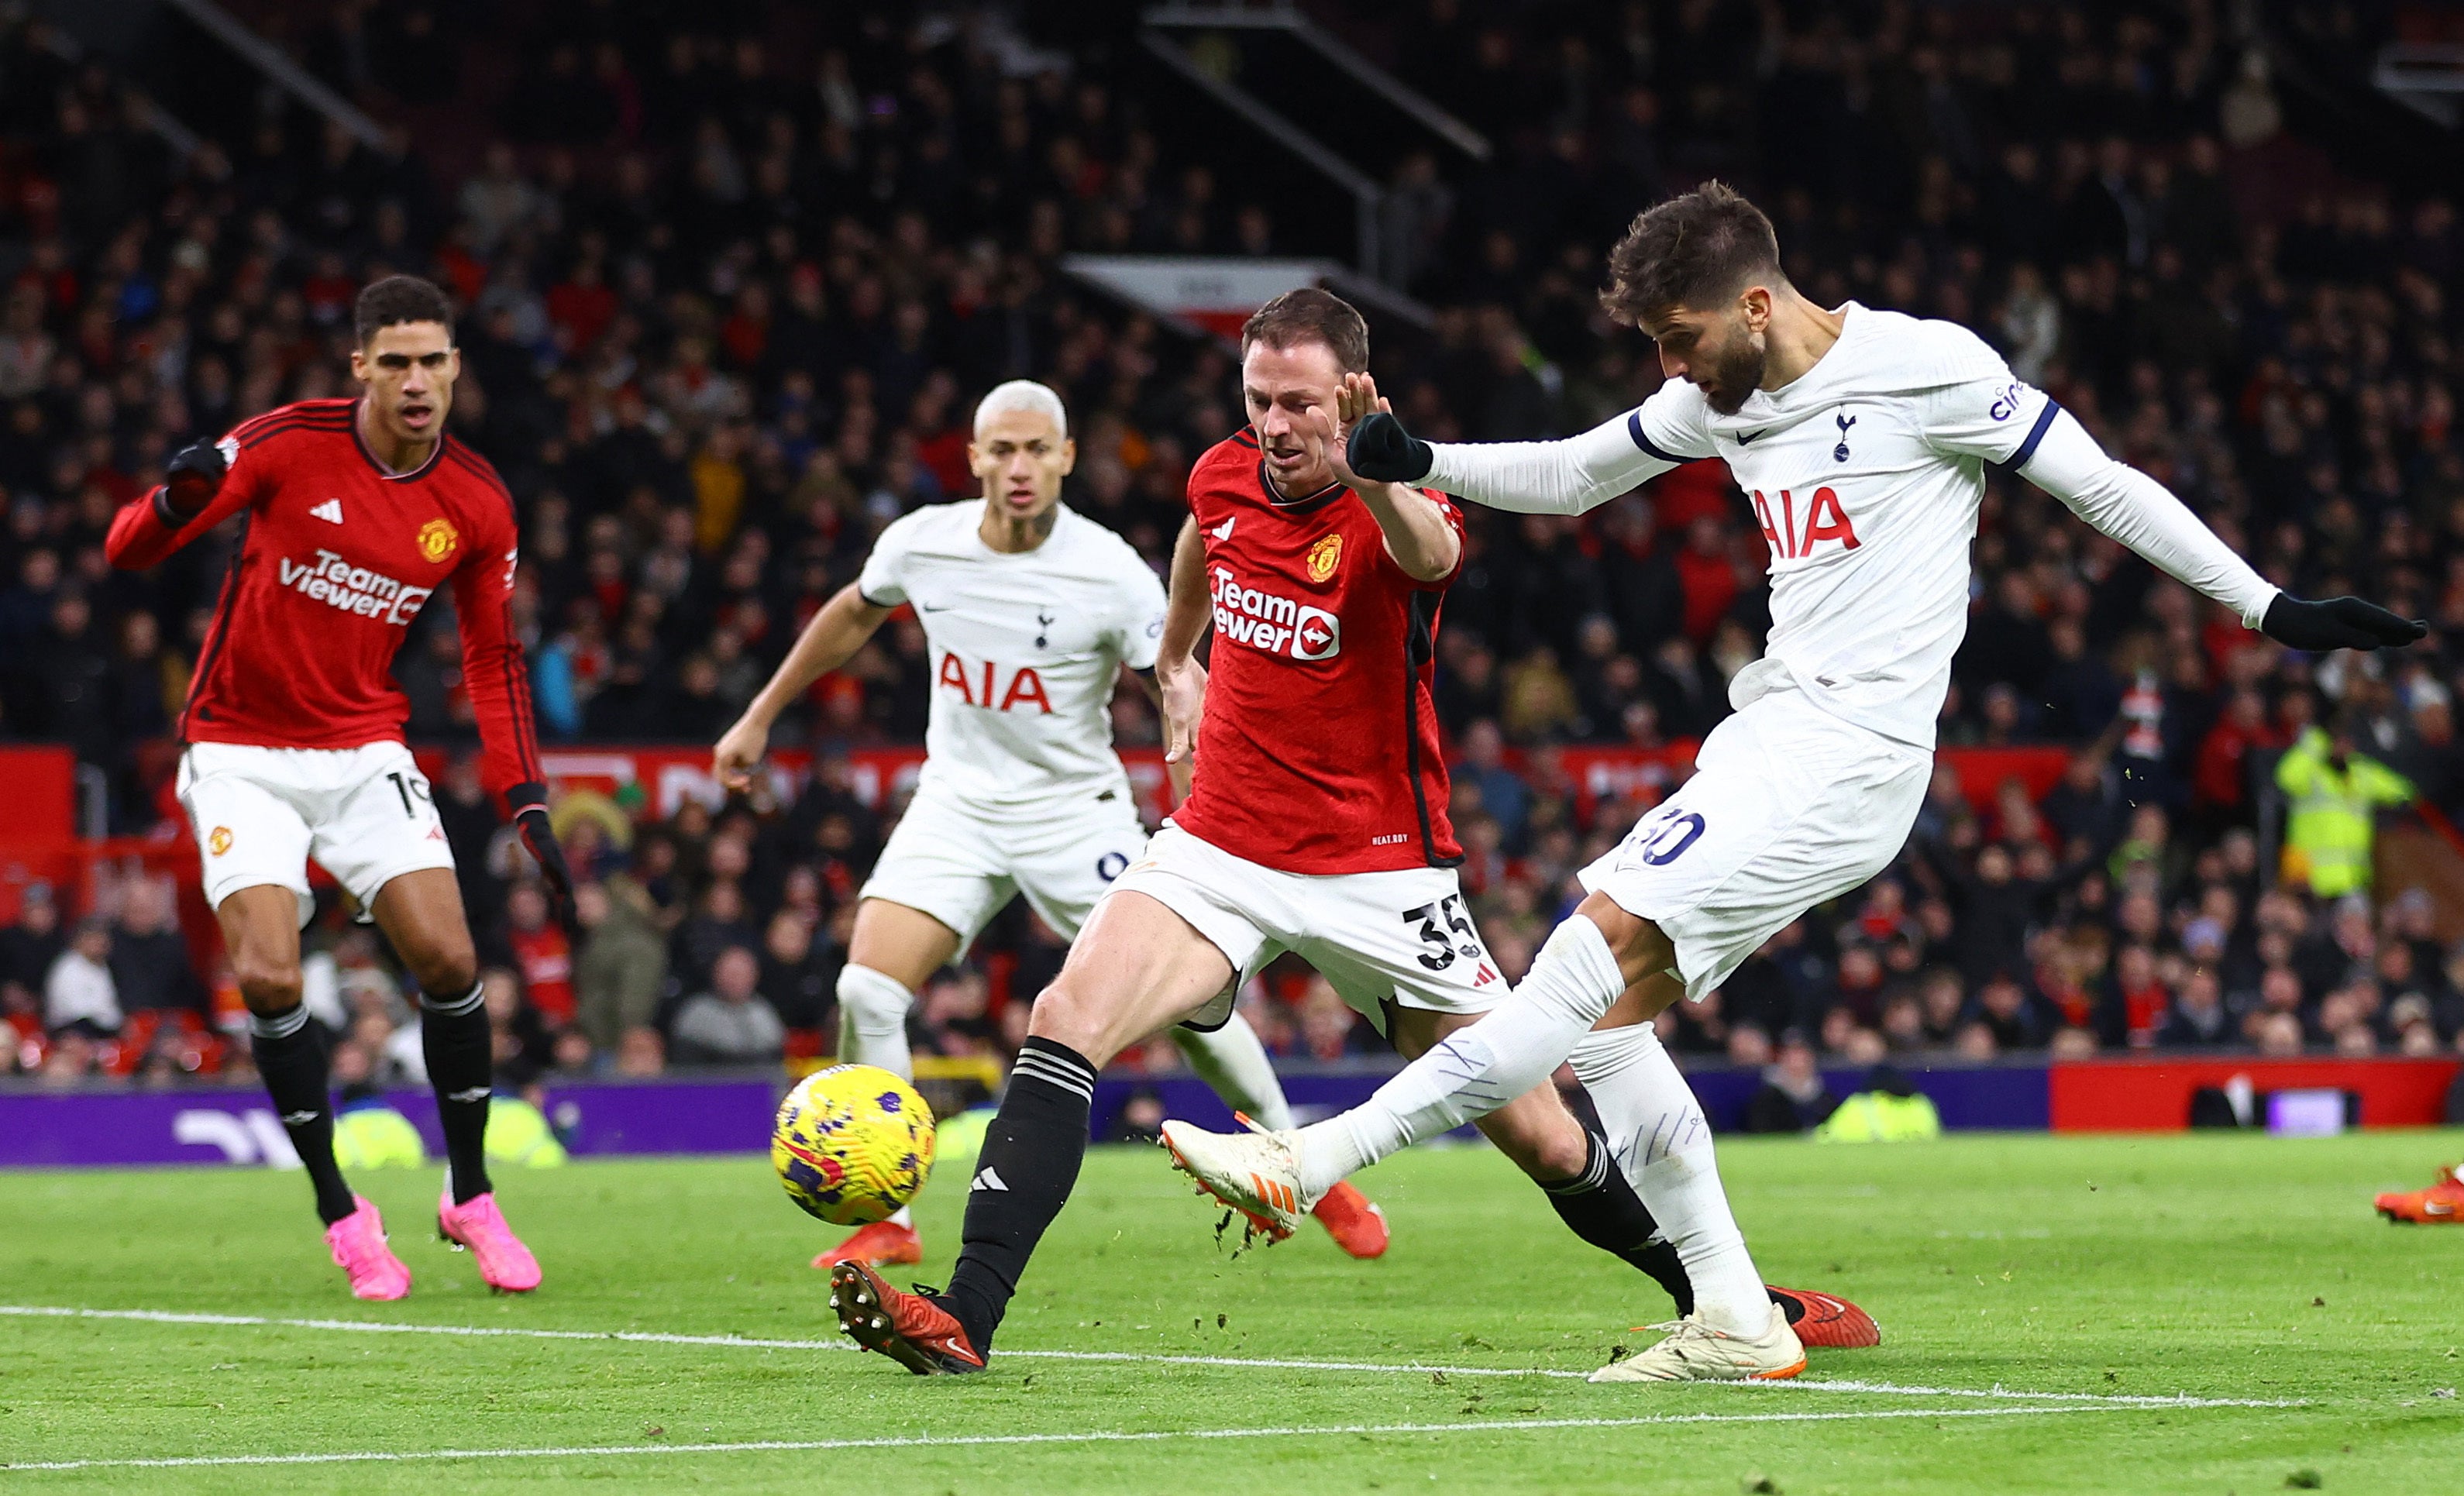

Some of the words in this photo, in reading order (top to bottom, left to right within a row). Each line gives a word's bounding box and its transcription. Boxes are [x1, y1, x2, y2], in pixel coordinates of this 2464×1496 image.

[1754, 487, 1862, 559] AIA
[280, 556, 391, 618] Viewer
[316, 549, 401, 600] Team
[1215, 566, 1297, 627] Team
[940, 652, 1052, 714] AIA
[1402, 892, 1481, 972] 35
